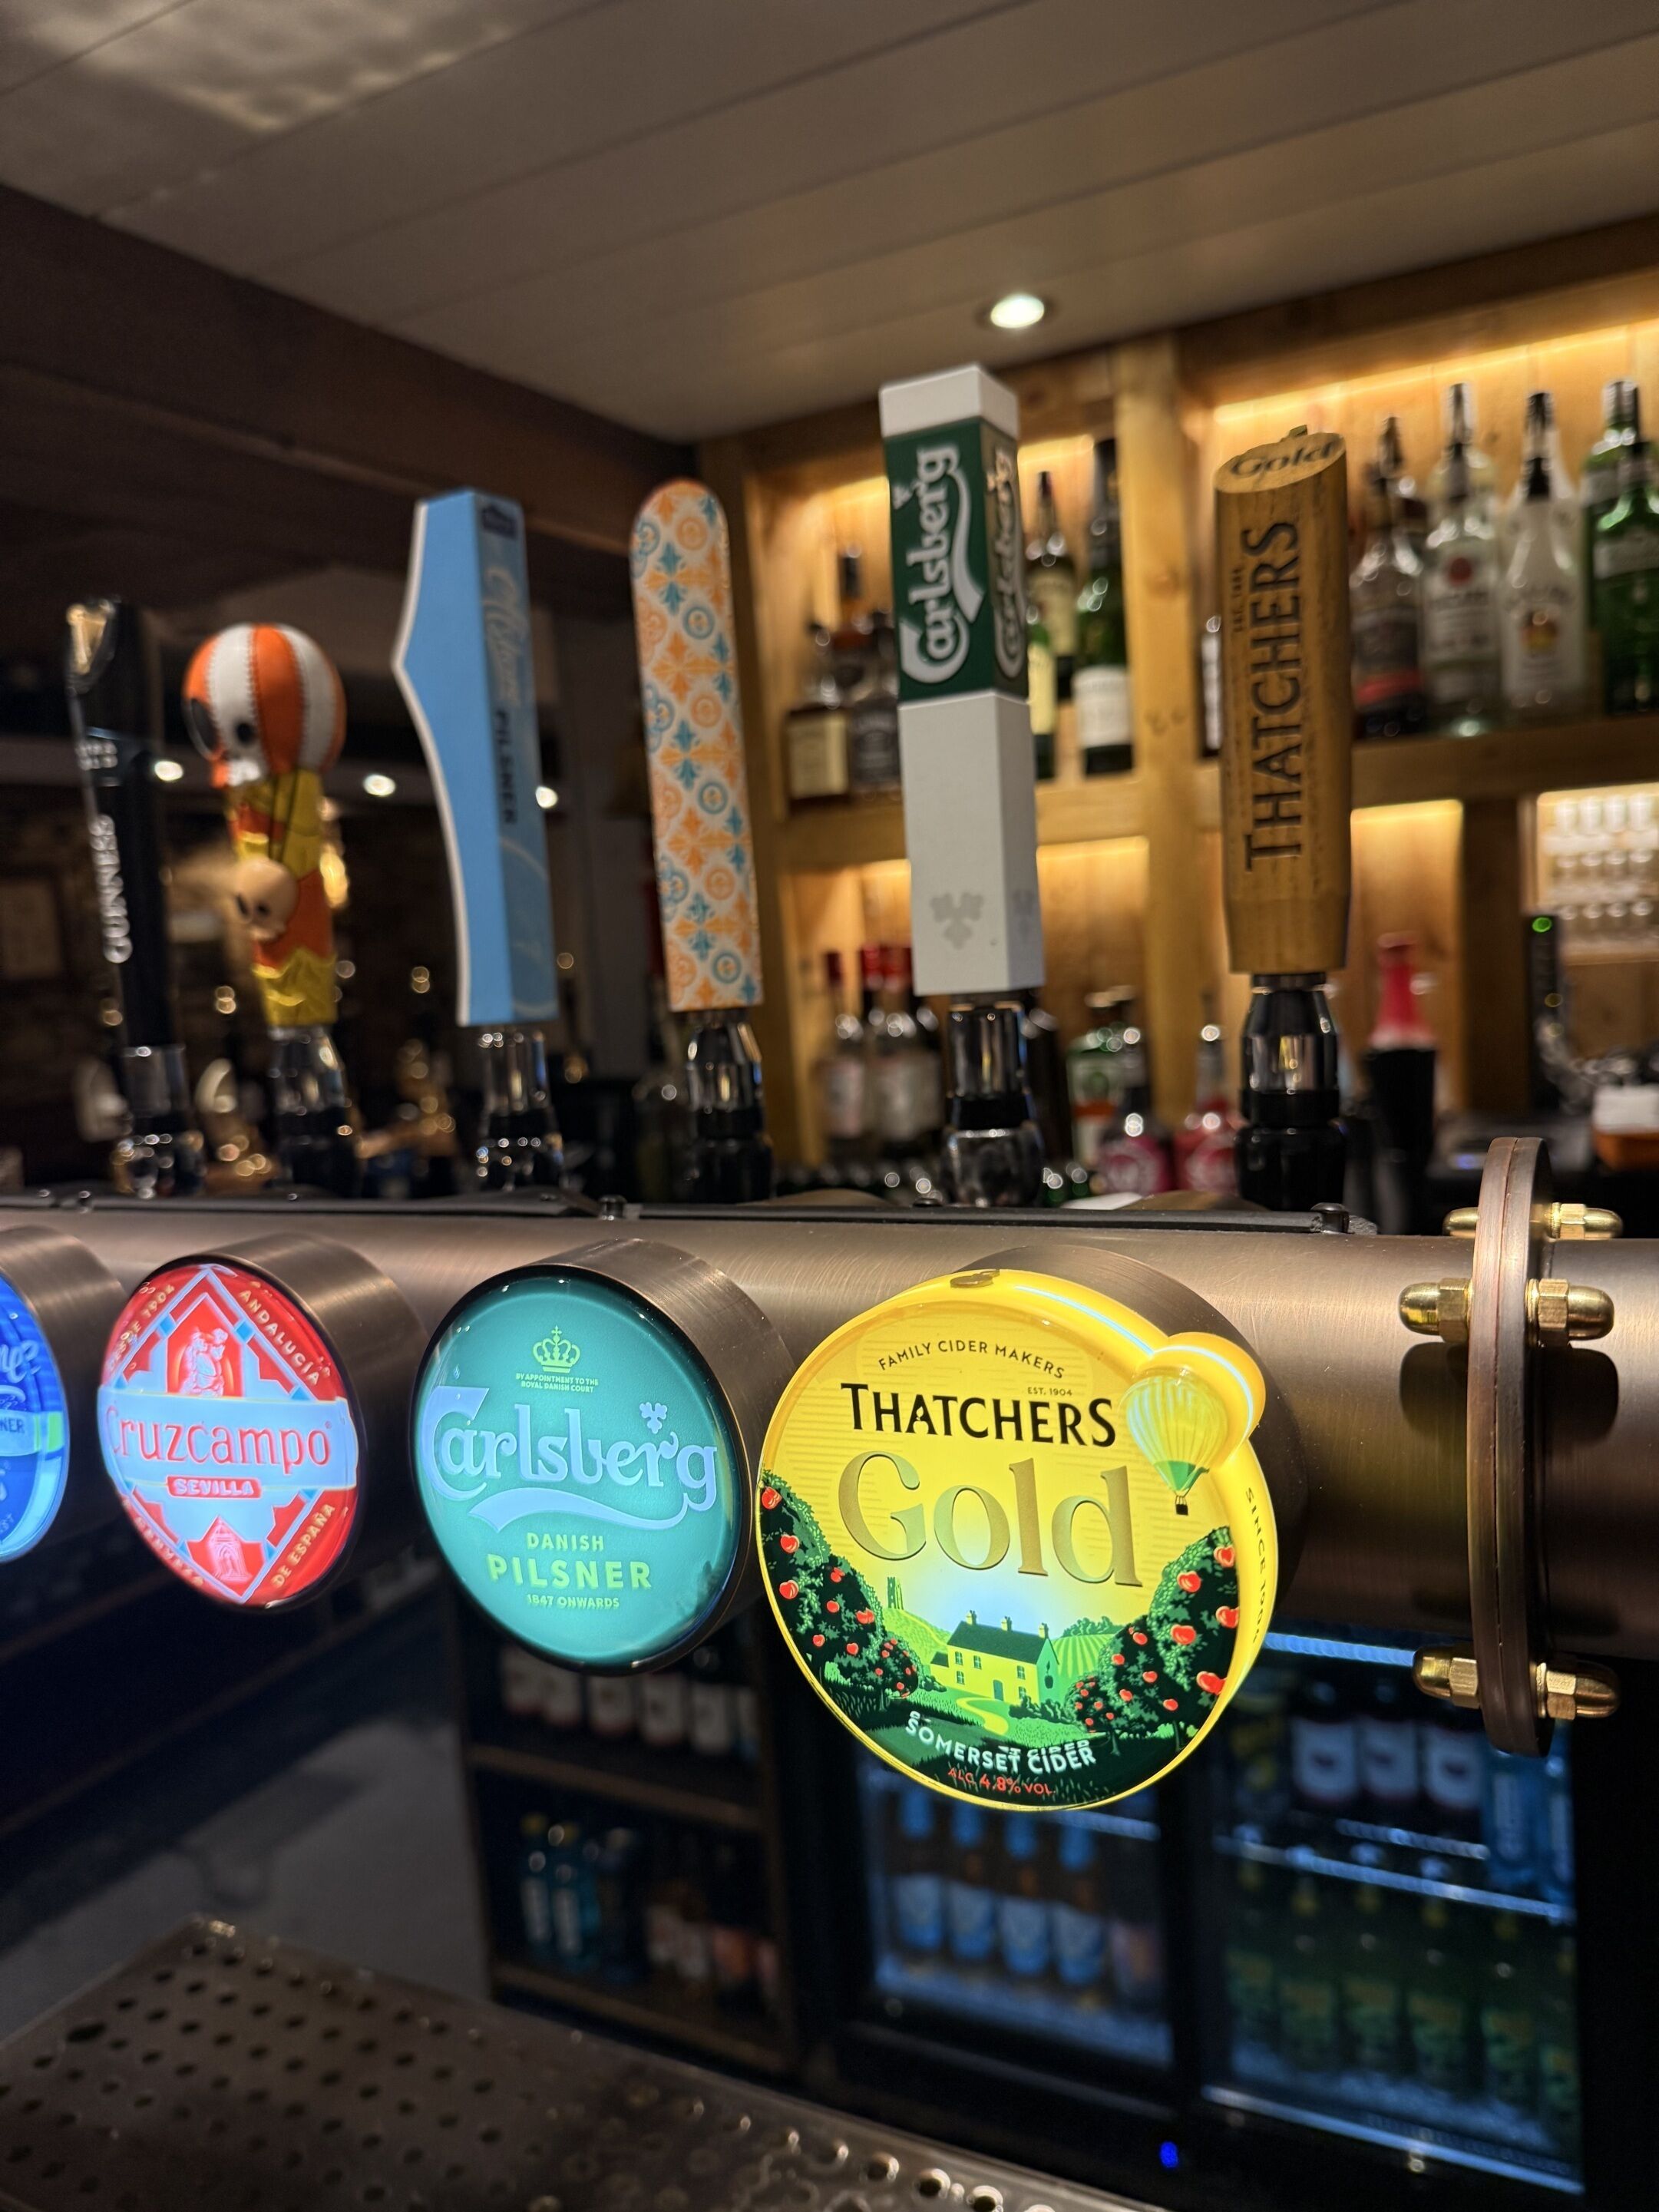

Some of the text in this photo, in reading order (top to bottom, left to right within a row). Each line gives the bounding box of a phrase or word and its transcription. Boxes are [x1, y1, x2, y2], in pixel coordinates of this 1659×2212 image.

[895, 444, 985, 684] Carlsberg
[1241, 521, 1304, 873] THATCHERS
[494, 709, 519, 824] PILSNER
[521, 1380, 543, 1389] ROYAL
[544, 1383, 570, 1392] DANISH
[525, 1374, 573, 1384] APPOINTMENT
[586, 1377, 599, 1386] THE
[878, 1340, 1066, 1379] FAMILY CIDER MAKERS
[841, 1382, 1116, 1447] THATCHERS
[1027, 1387, 1073, 1397] EST. 1904
[105, 1404, 332, 1475] Cruzcampo
[421, 1385, 718, 1532] Carlsberg
[174, 1478, 254, 1496] SEVILLA
[271, 1504, 335, 1589] DE ESPAÑA
[526, 1533, 604, 1551] DANISH
[838, 1450, 1142, 1588] Gold
[1245, 1487, 1266, 1574] SINCE
[487, 1553, 652, 1589] PILSNER
[526, 1593, 620, 1610] 1847 ONWARDS
[905, 1717, 1097, 1774] SOMERSET CIDER
[980, 1773, 1022, 1794] 4.8%
